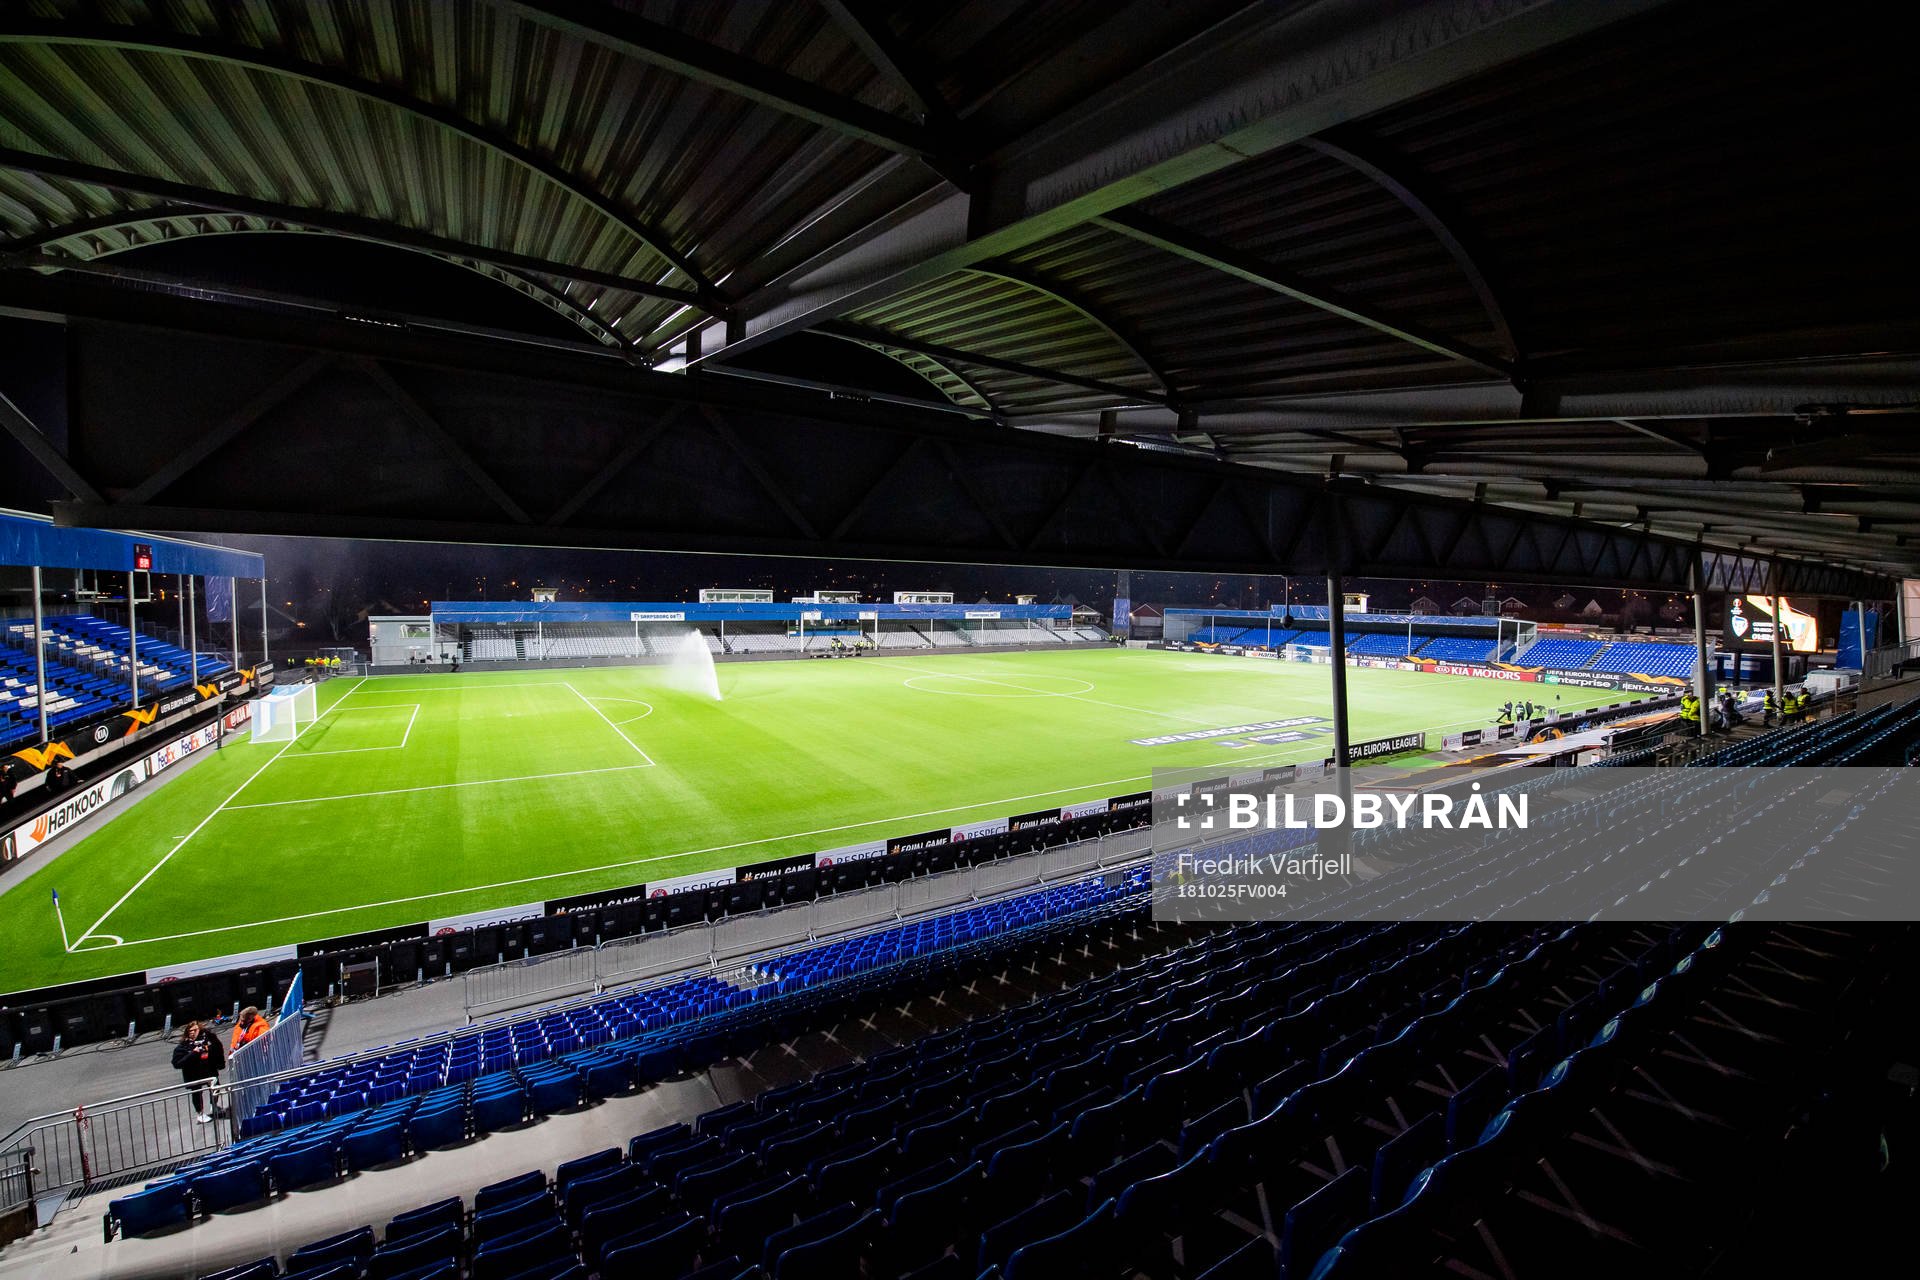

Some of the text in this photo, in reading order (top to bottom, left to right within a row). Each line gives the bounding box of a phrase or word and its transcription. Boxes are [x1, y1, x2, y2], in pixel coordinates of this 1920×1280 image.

[1451, 666, 1520, 681] KIA MOTORS
[1564, 671, 1591, 679] EUROPA
[1591, 673, 1620, 681] LEAGUE
[1622, 683, 1670, 694] RENT-A-CAR
[204, 724, 218, 743] FedE
[181, 735, 200, 756] FedEx
[1348, 736, 1417, 759] EFA EUROPA LEAGUE
